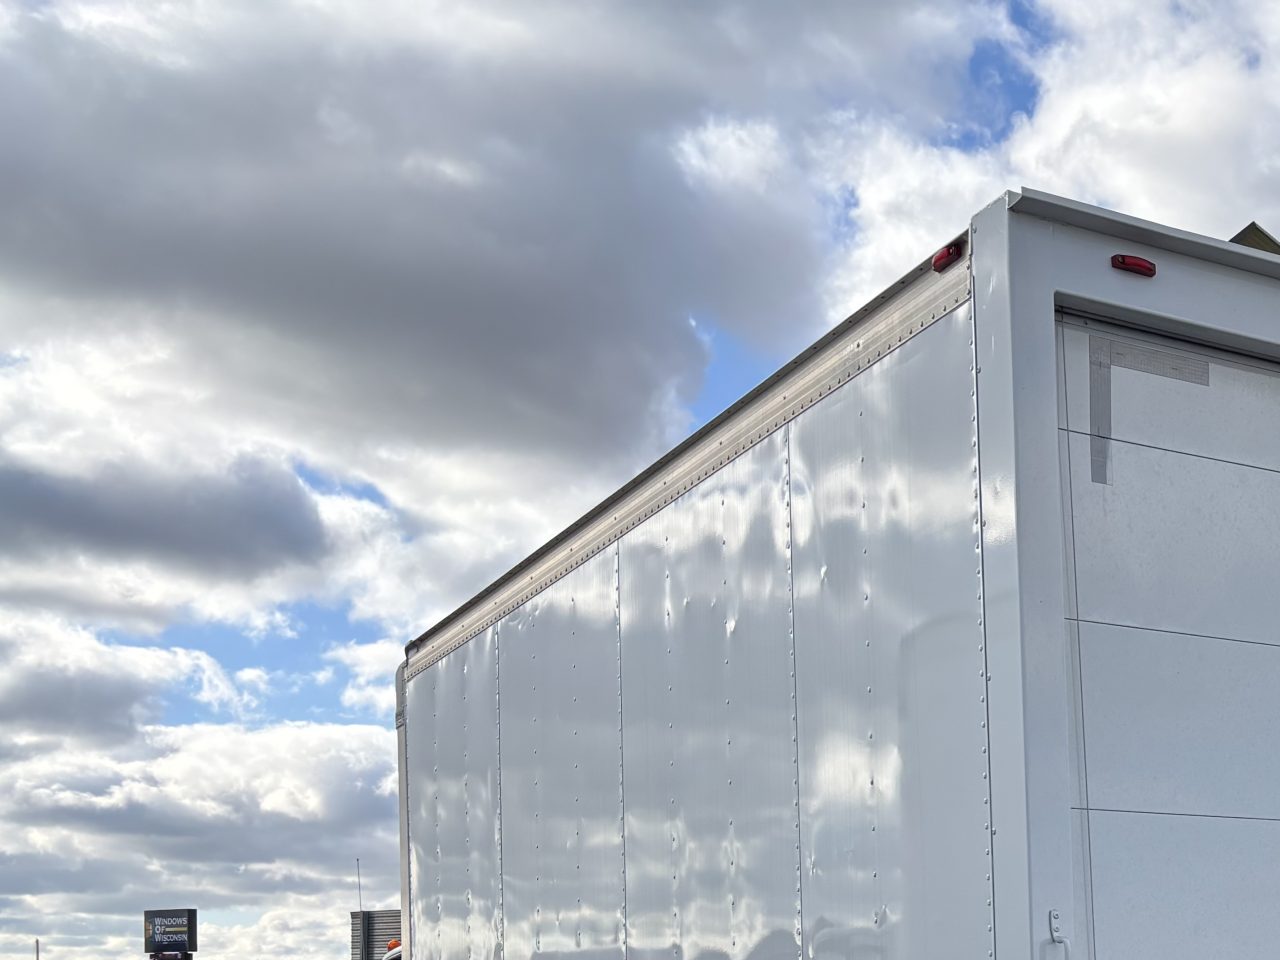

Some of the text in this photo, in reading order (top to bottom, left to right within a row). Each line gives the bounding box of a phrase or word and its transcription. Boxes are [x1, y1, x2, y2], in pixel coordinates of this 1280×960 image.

[154, 917, 188, 926] WINDOWS
[154, 925, 166, 933] OF
[154, 933, 188, 942] WISCONSIN
